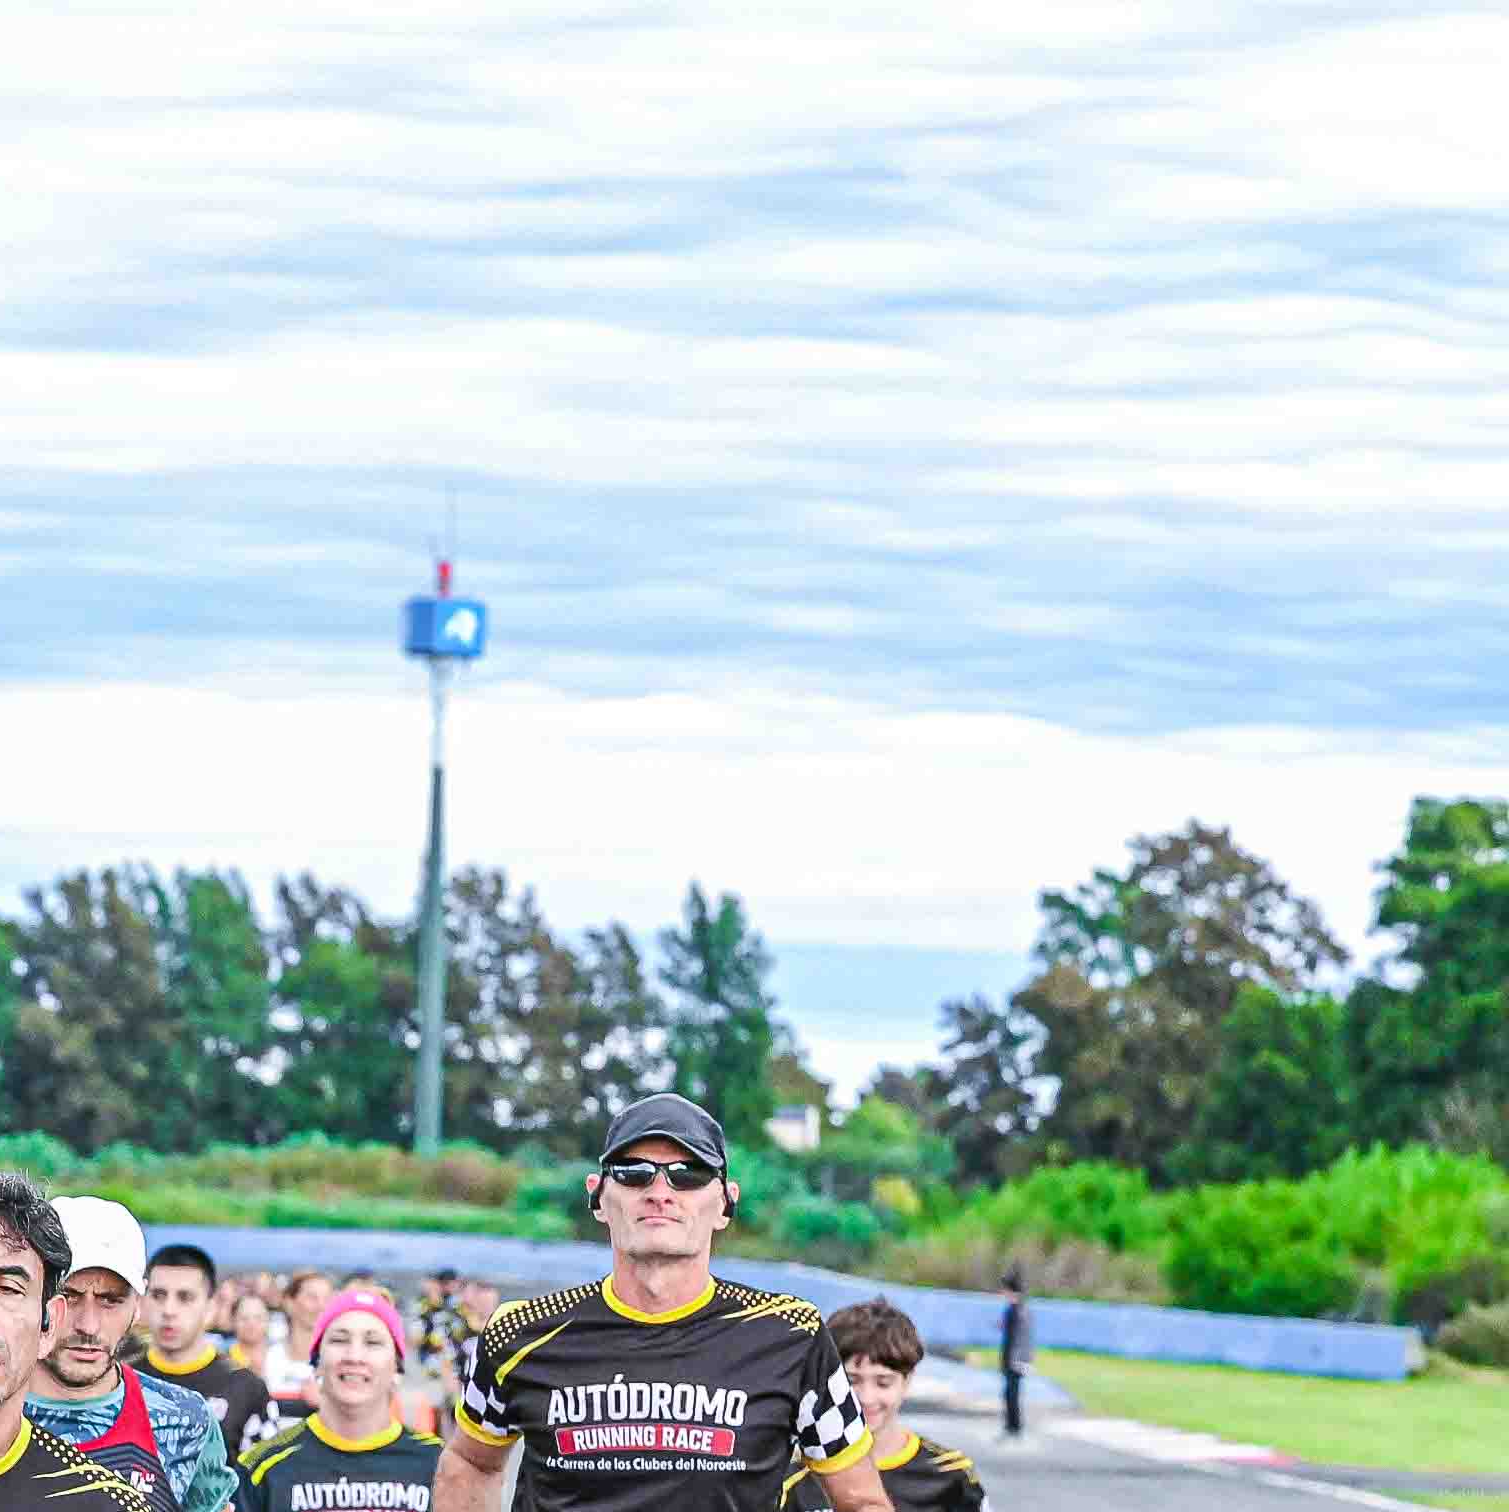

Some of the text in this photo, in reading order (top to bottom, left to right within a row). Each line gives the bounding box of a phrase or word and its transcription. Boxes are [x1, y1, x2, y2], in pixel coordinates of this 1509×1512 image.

[548, 1373, 748, 1427] AUTÓDROMO
[572, 1426, 714, 1451] RUNNING RACE
[557, 1457, 595, 1471] Carrera
[597, 1457, 612, 1470] de
[614, 1457, 631, 1470] los
[633, 1457, 673, 1471] Clubes
[676, 1456, 694, 1470] del
[697, 1458, 746, 1471] Noroeste
[292, 1476, 430, 1512] AUTÓDROMO
